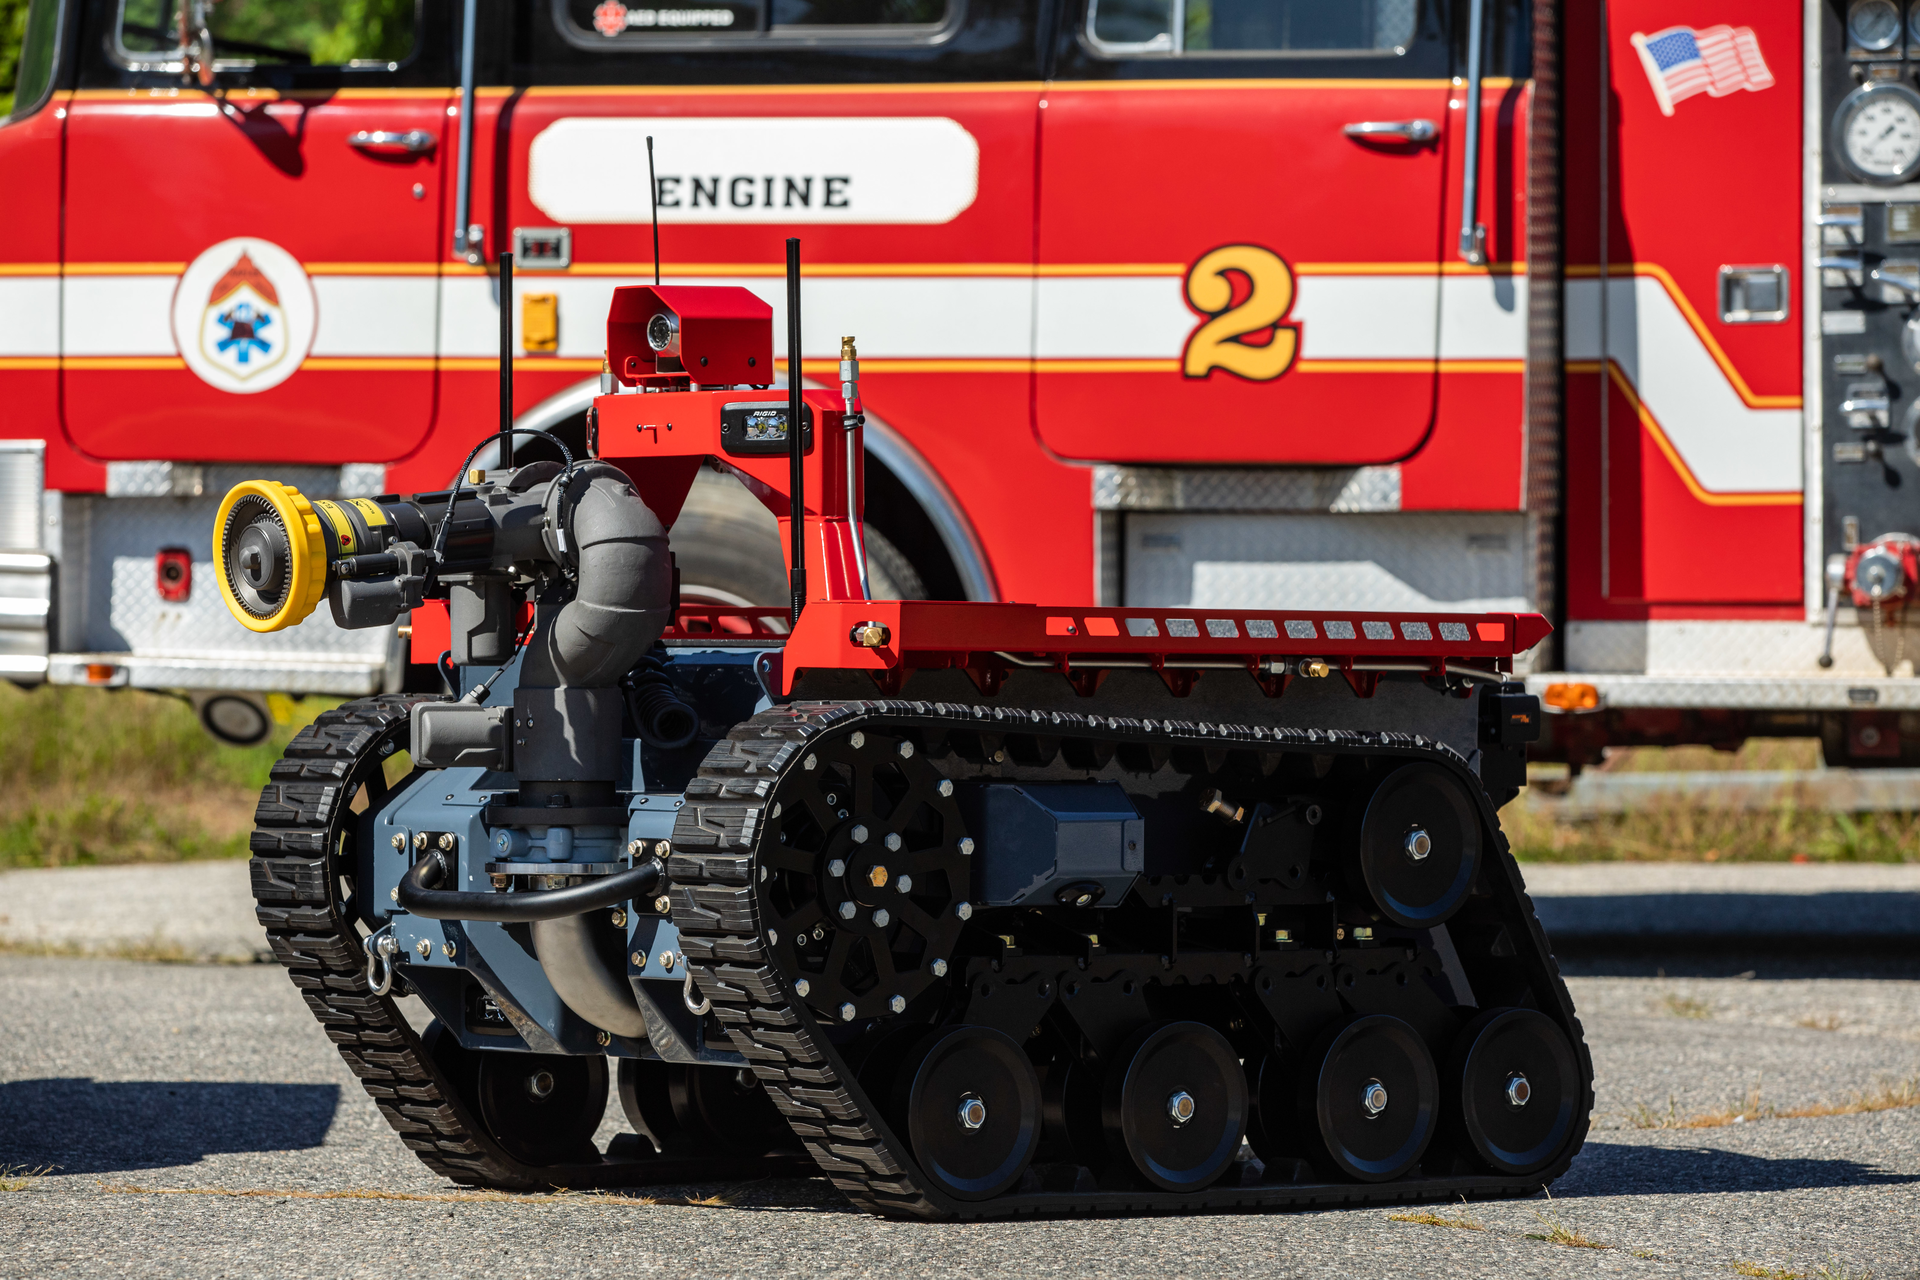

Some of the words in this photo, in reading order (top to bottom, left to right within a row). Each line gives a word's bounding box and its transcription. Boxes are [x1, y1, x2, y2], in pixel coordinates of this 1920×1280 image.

[658, 9, 734, 27] EQUIPPED
[655, 176, 851, 208] ENGINE
[1184, 243, 1298, 381] 2
